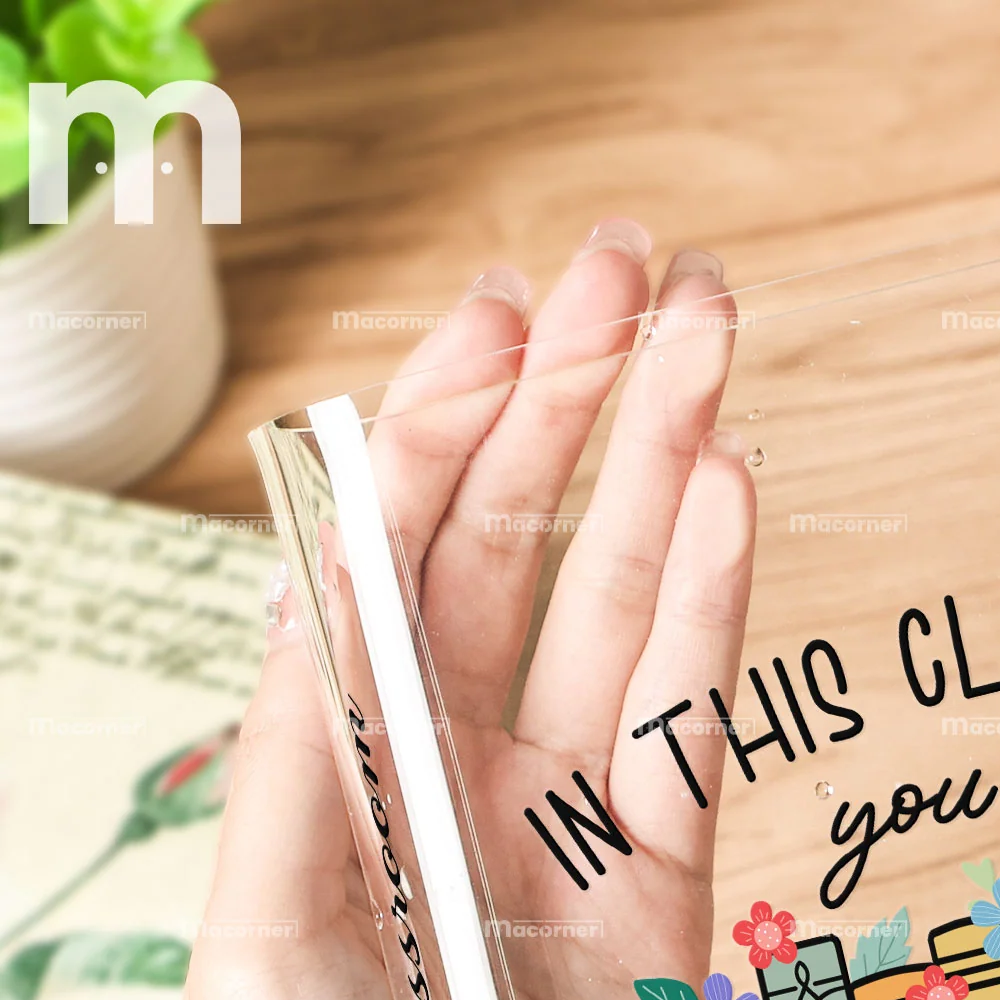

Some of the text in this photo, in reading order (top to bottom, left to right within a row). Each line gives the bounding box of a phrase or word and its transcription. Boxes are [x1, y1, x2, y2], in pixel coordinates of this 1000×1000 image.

[524, 770, 633, 891] IN
[631, 639, 864, 809] THIS
[819, 769, 999, 910] you
